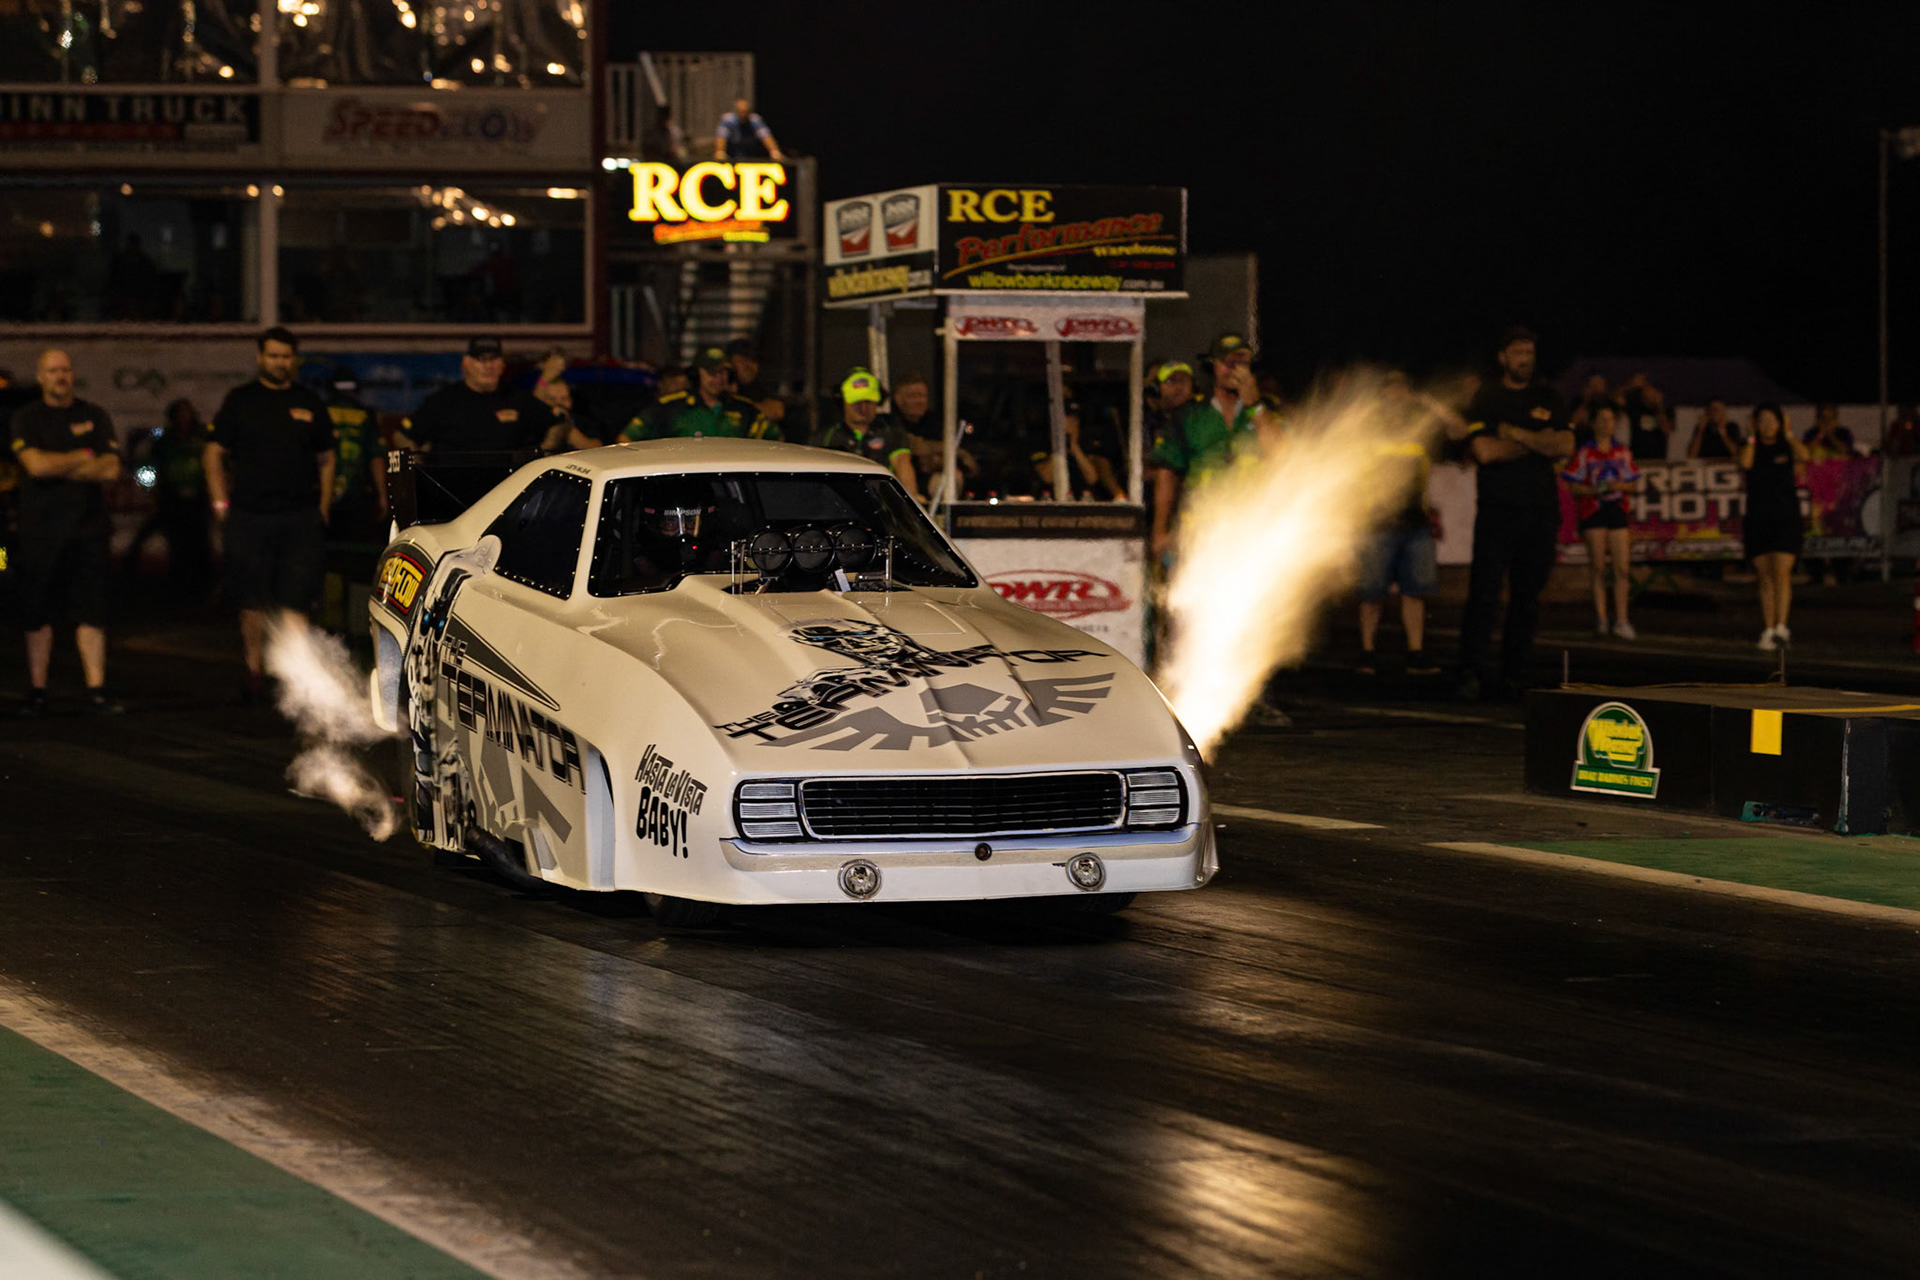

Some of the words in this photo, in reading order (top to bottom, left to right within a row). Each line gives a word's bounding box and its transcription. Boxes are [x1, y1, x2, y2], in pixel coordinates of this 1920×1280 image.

[0, 96, 87, 121] INN
[105, 96, 247, 122] TRUCK
[628, 161, 790, 222] RCE
[947, 189, 1056, 223] RCE
[955, 212, 1163, 265] Performance
[443, 634, 468, 666] THE
[727, 643, 1112, 742] TERMINATOR
[441, 662, 587, 795] TERMINATOR
[714, 711, 779, 733] THE
[635, 744, 674, 794] HASTA
[673, 769, 708, 815] VISTA
[636, 786, 688, 858] BABY!
